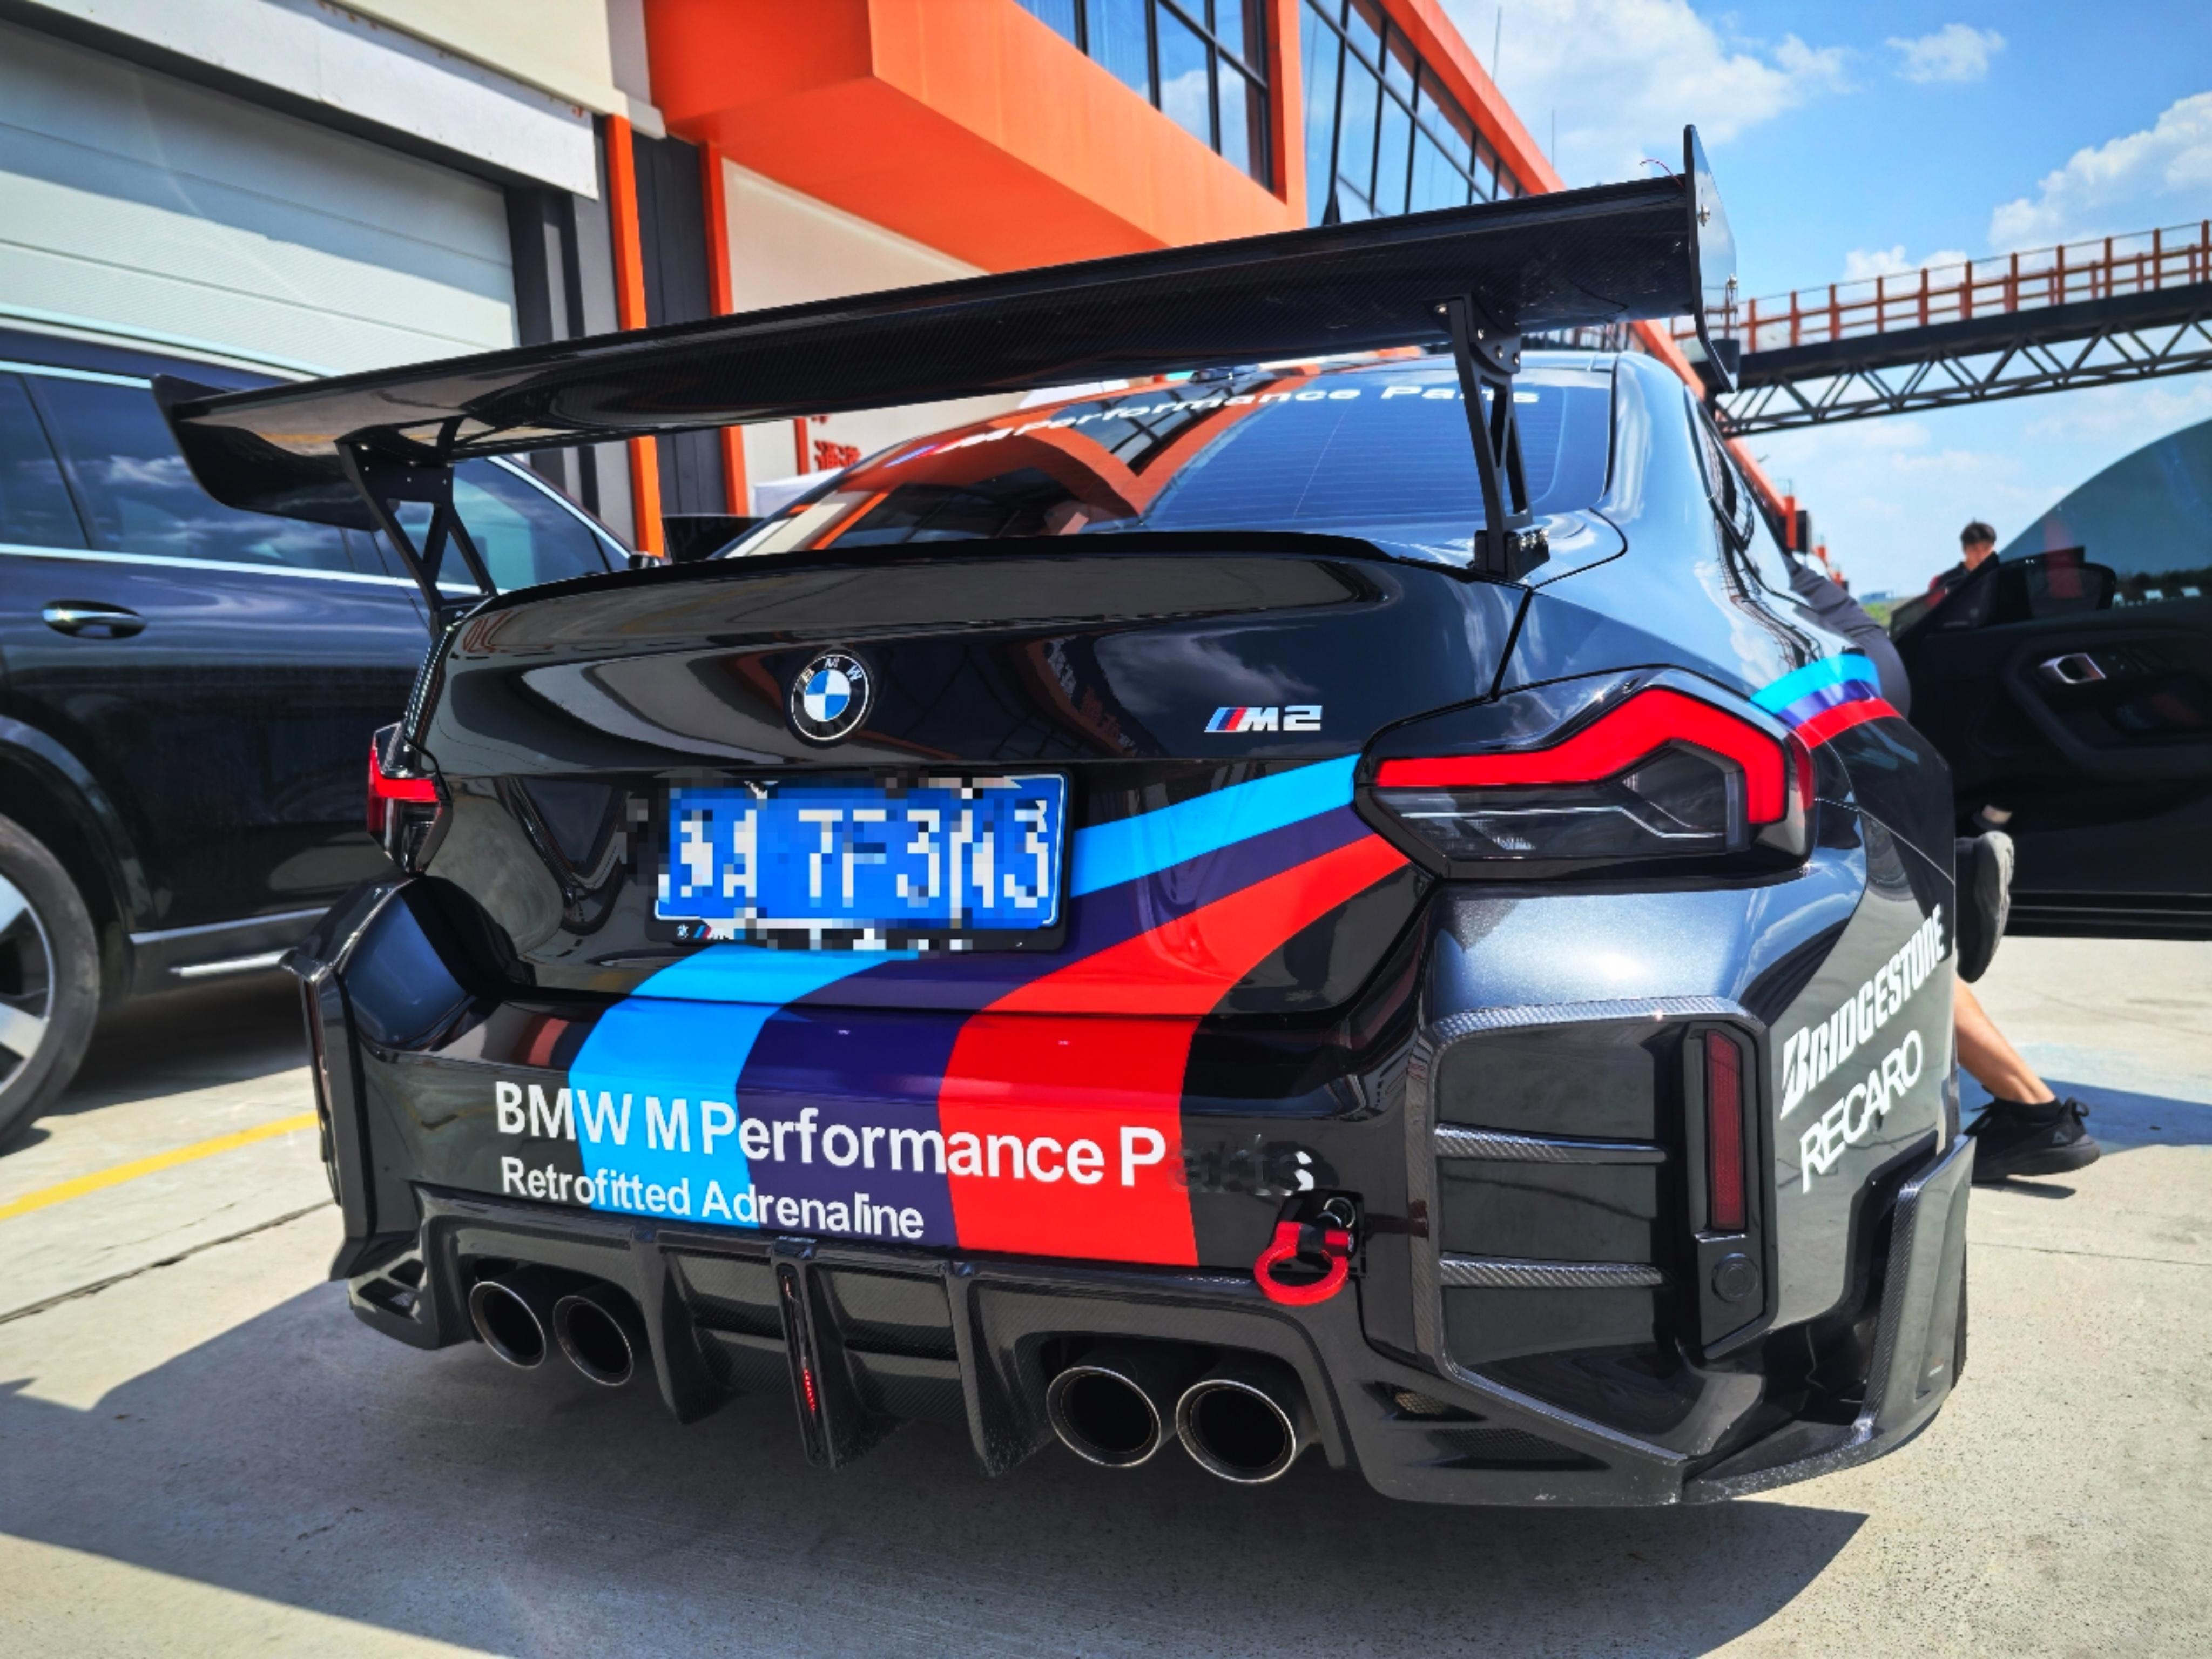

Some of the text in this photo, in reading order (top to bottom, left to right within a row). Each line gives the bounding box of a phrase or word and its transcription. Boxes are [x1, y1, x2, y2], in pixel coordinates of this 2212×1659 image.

[1014, 387, 1361, 436] Performance
[1380, 385, 1540, 404] Pats
[800, 657, 863, 684] BMW
[1233, 705, 1323, 732] M2
[1780, 903, 1945, 1120] BRIDGESTONE
[495, 1081, 632, 1145] BMW
[646, 1096, 691, 1153] M
[700, 1100, 1105, 1185] Performance
[1799, 1029, 1923, 1194] RECARO
[501, 1156, 925, 1240] Retrofitted Adrenaline
